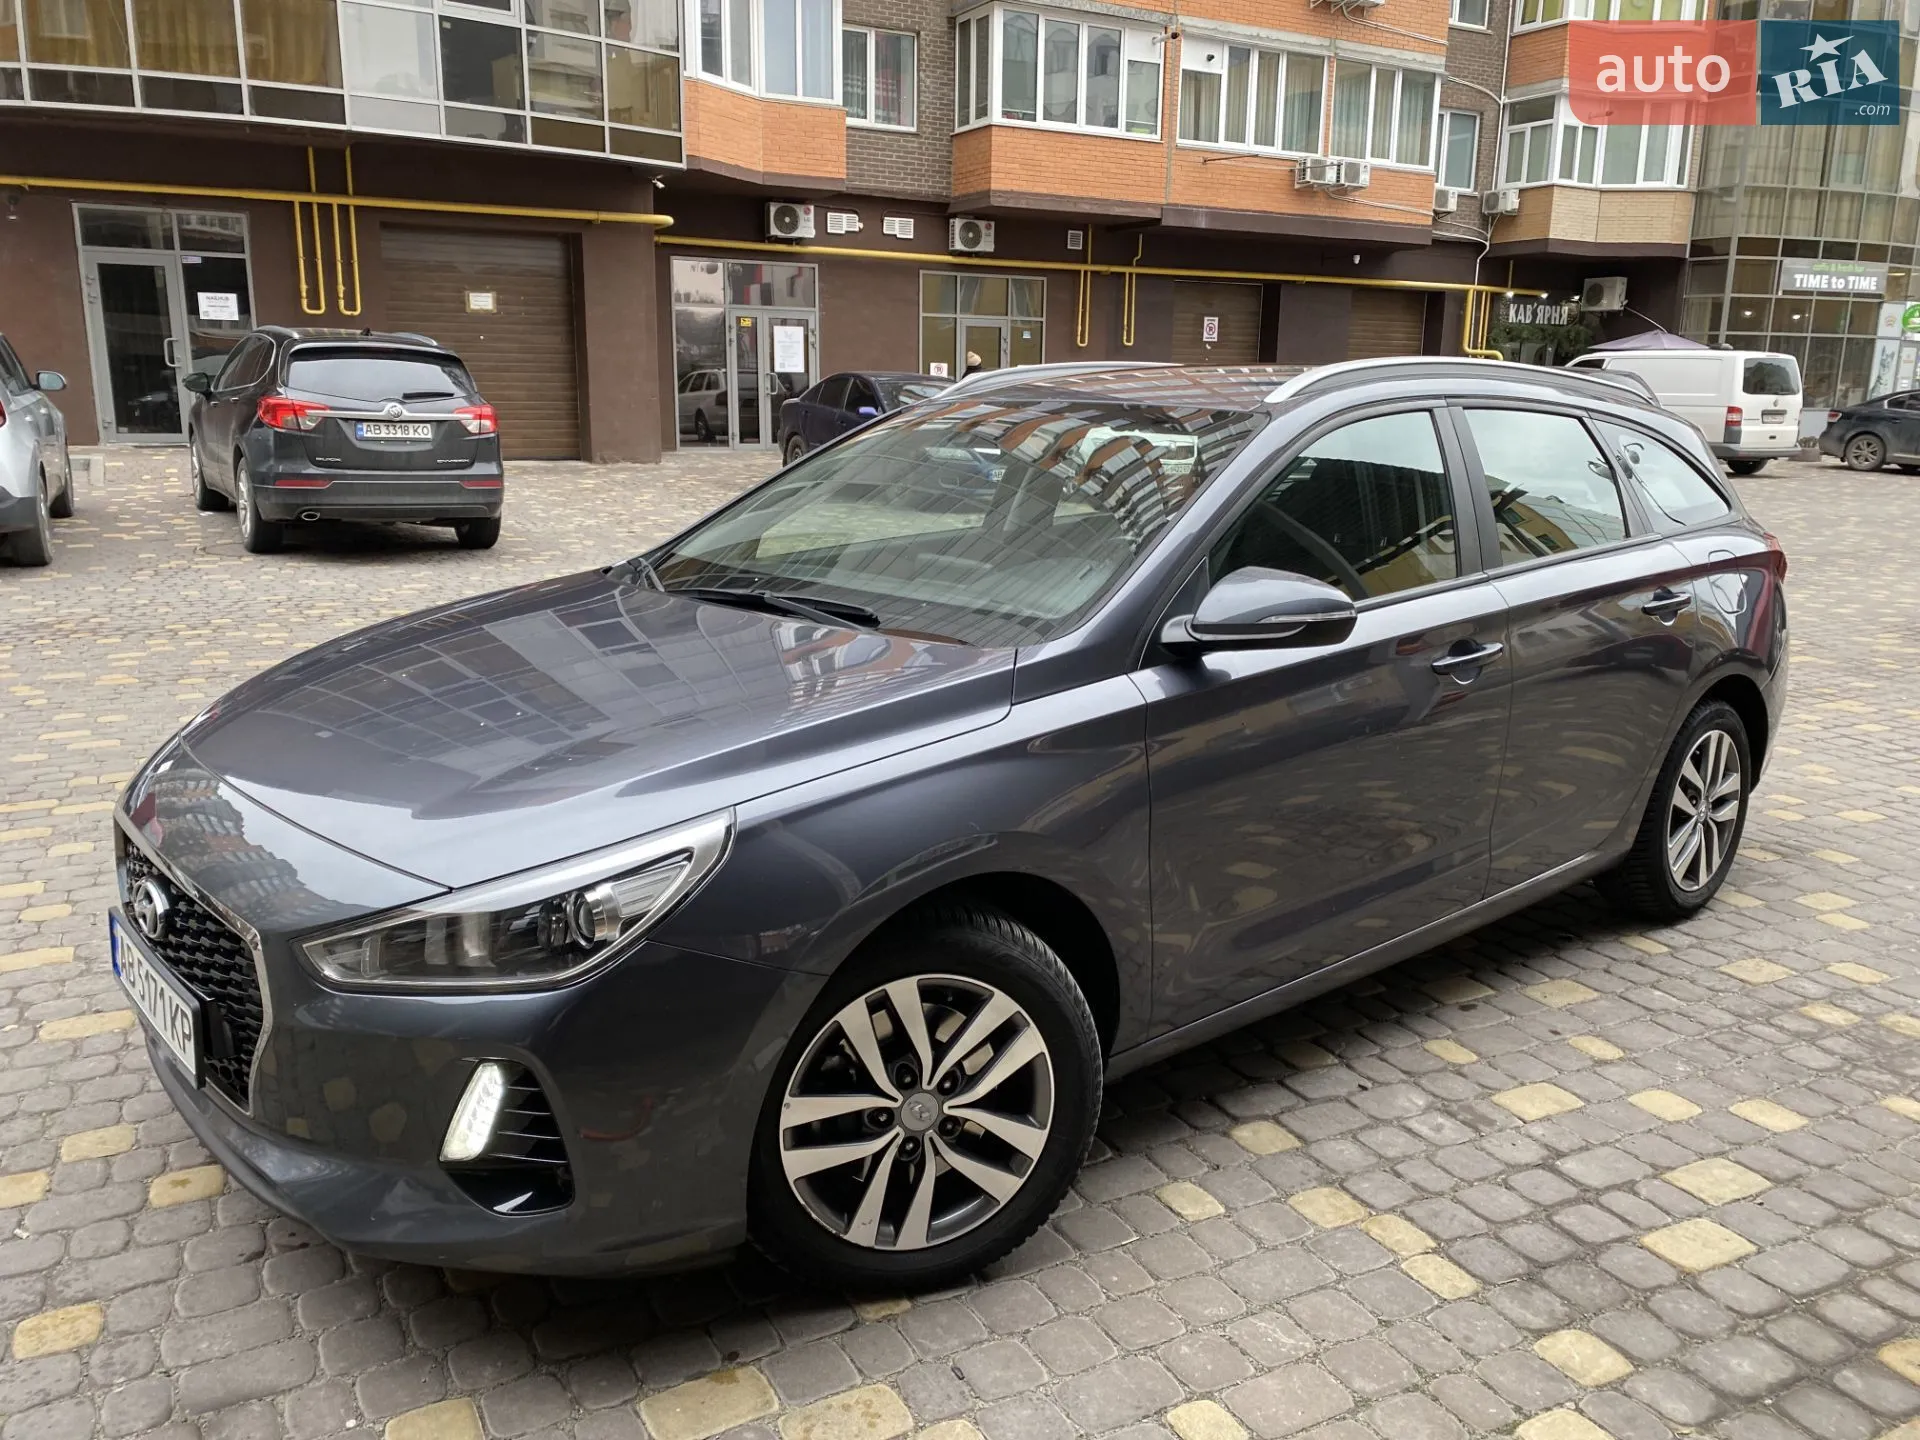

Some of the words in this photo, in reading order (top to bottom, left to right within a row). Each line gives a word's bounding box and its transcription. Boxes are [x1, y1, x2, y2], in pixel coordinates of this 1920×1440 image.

[1794, 273, 1829, 289] TIME
[1831, 276, 1845, 289] to
[1847, 275, 1878, 290] TIME
[1508, 302, 1569, 325] КАВ'ЯРНЯ
[365, 423, 382, 434] AB
[385, 423, 410, 435] 3318
[120, 935, 136, 989] AB
[137, 959, 168, 1032] 5171
[169, 995, 192, 1055] KP
